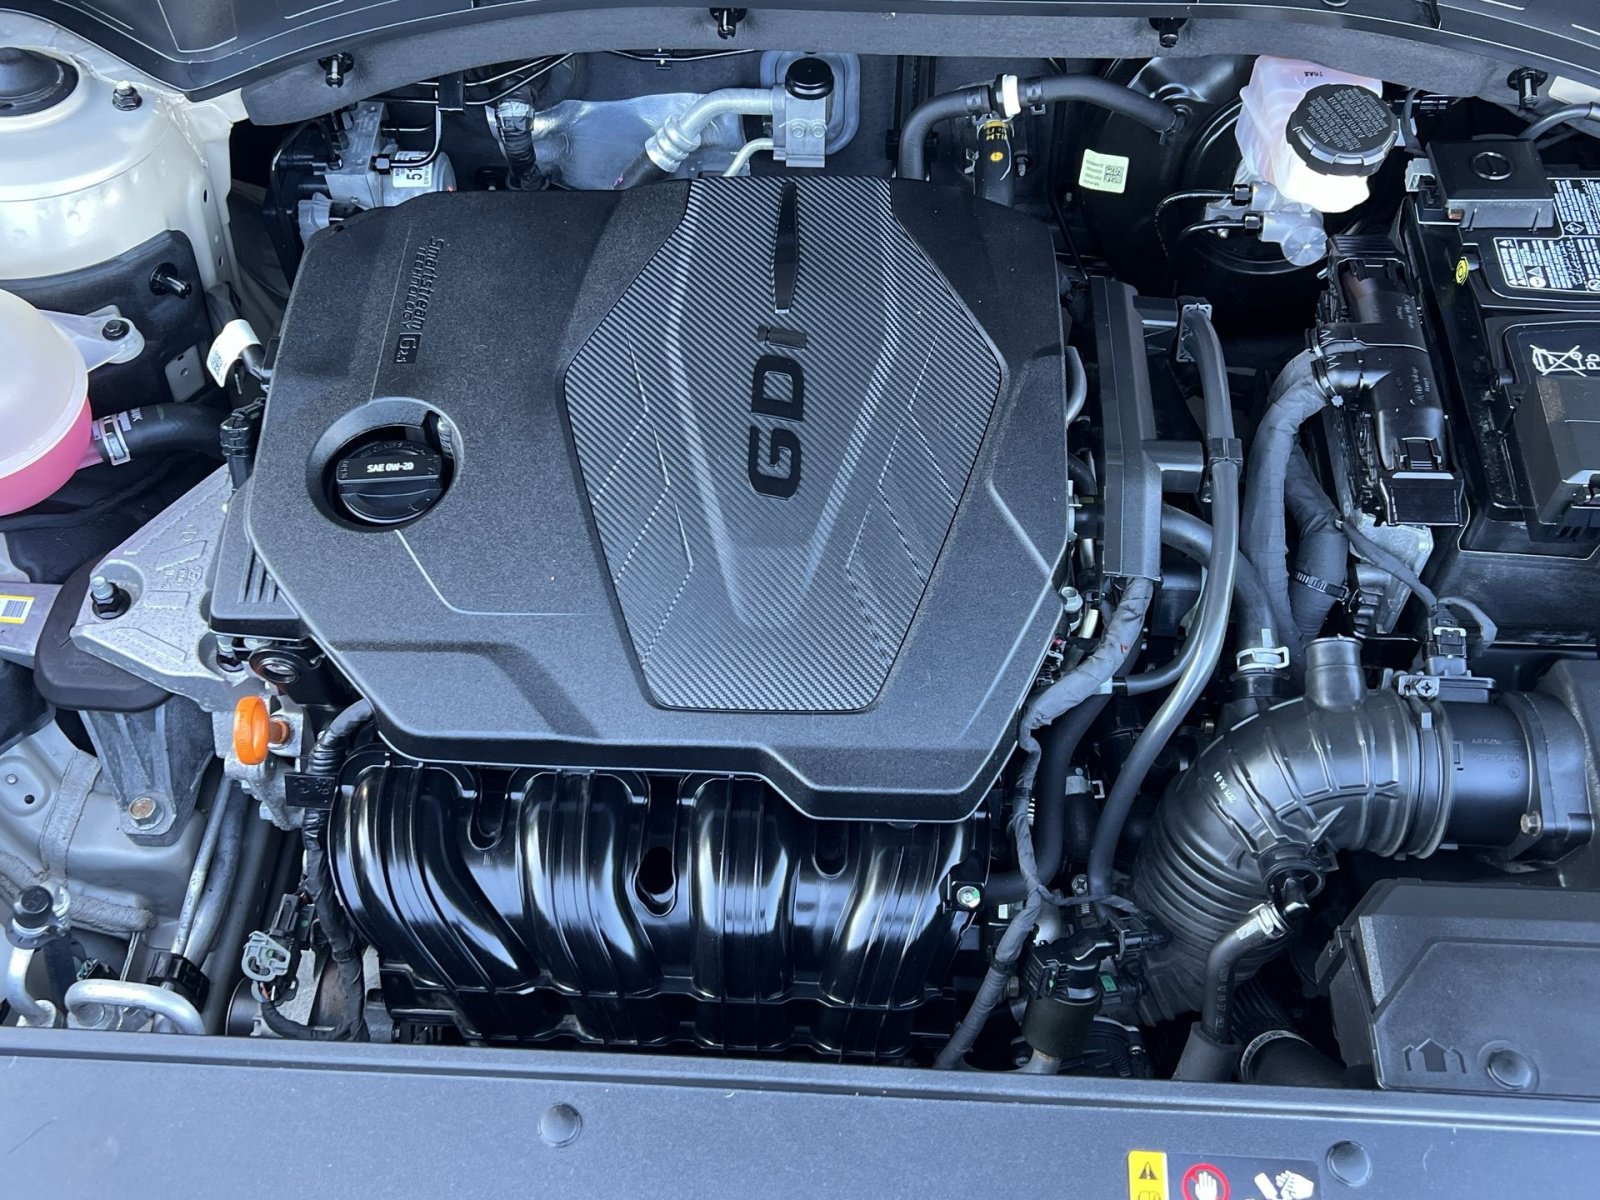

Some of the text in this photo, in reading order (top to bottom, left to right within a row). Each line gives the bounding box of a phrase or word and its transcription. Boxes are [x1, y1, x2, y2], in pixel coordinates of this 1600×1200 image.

[1305, 115, 1330, 144] WARNING
[400, 246, 426, 329] TECHNOLOGY
[411, 236, 445, 330] Smartstream
[1585, 353, 1600, 371] Pb
[749, 325, 808, 500] GDi
[366, 461, 414, 473] SAE 0W-20
